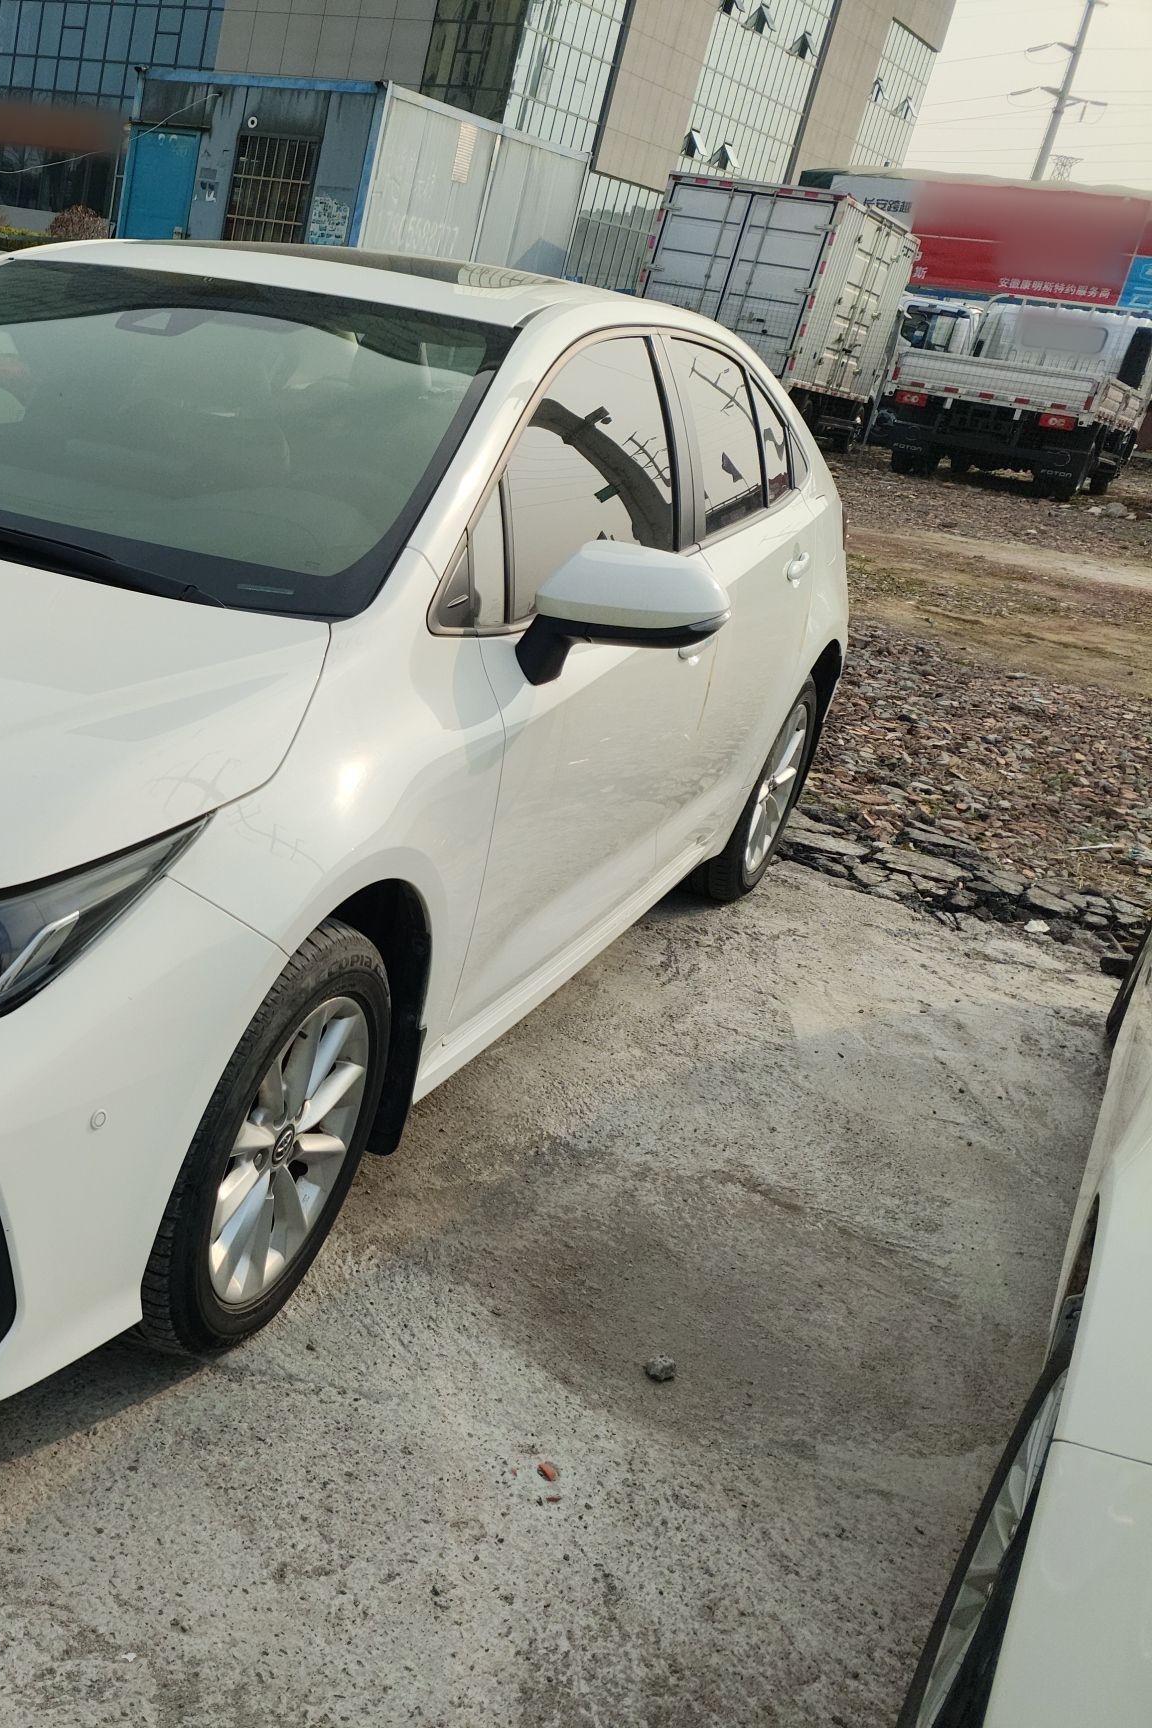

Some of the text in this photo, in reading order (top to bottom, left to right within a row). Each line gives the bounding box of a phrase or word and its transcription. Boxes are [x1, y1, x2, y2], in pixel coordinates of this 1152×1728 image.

[998, 277, 1112, 299] 安徽康明斯特约服务商
